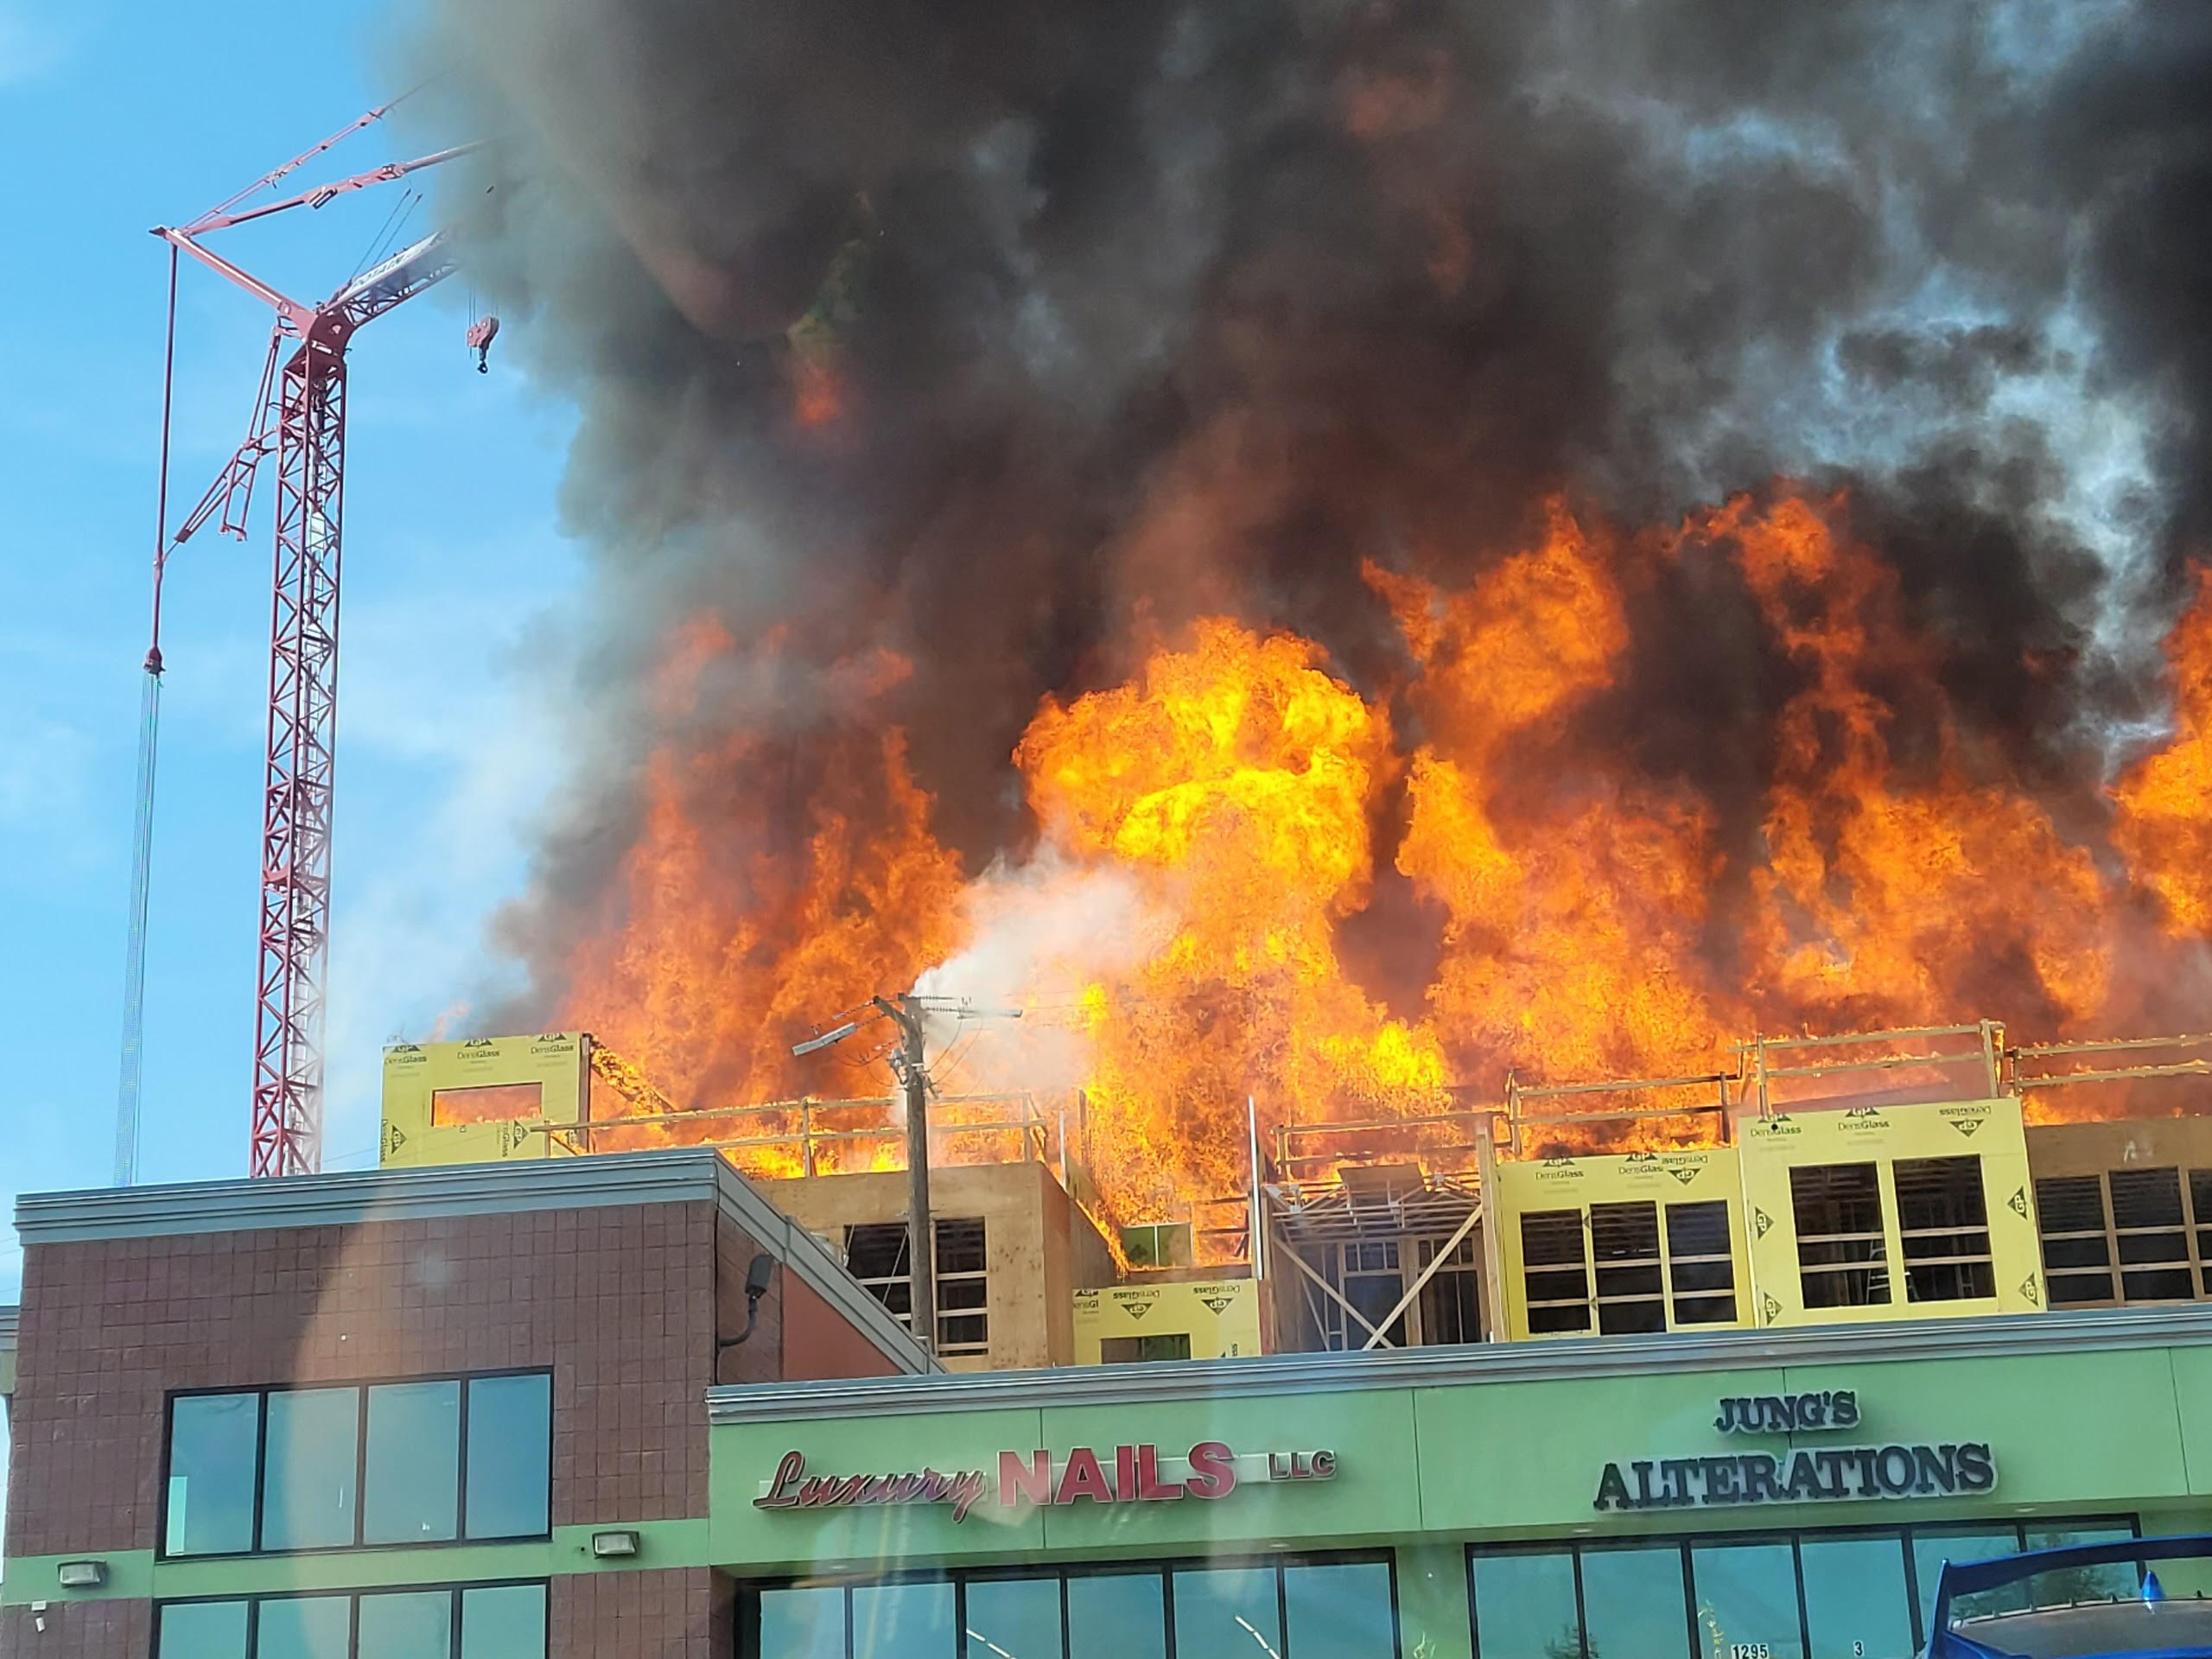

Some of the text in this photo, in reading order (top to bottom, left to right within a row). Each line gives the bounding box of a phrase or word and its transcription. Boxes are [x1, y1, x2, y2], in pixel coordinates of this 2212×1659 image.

[456, 1050, 500, 1059] DensGlass
[531, 1045, 574, 1054] DensGlass
[384, 1055, 428, 1065] DensGlass
[1938, 1105, 1992, 1116] DensGlass
[1838, 1120, 1891, 1131] DensGlass
[1535, 1169, 1585, 1181] DensGlass
[2013, 1194, 2025, 1213] GP
[1757, 1213, 1767, 1232] GP
[1112, 1289, 1160, 1300] DensGlass
[1193, 1285, 1241, 1295] DensGlass
[2024, 1281, 2036, 1300] GP
[1765, 1298, 1777, 1318] GP
[1714, 1390, 1859, 1432] JUNG'S
[753, 1440, 1337, 1523] Luxury NAILS LLC
[1593, 1443, 1996, 1510] ALTERATIONS
[1732, 1644, 1768, 1659] 1295
[1854, 1641, 1863, 1656] 3
